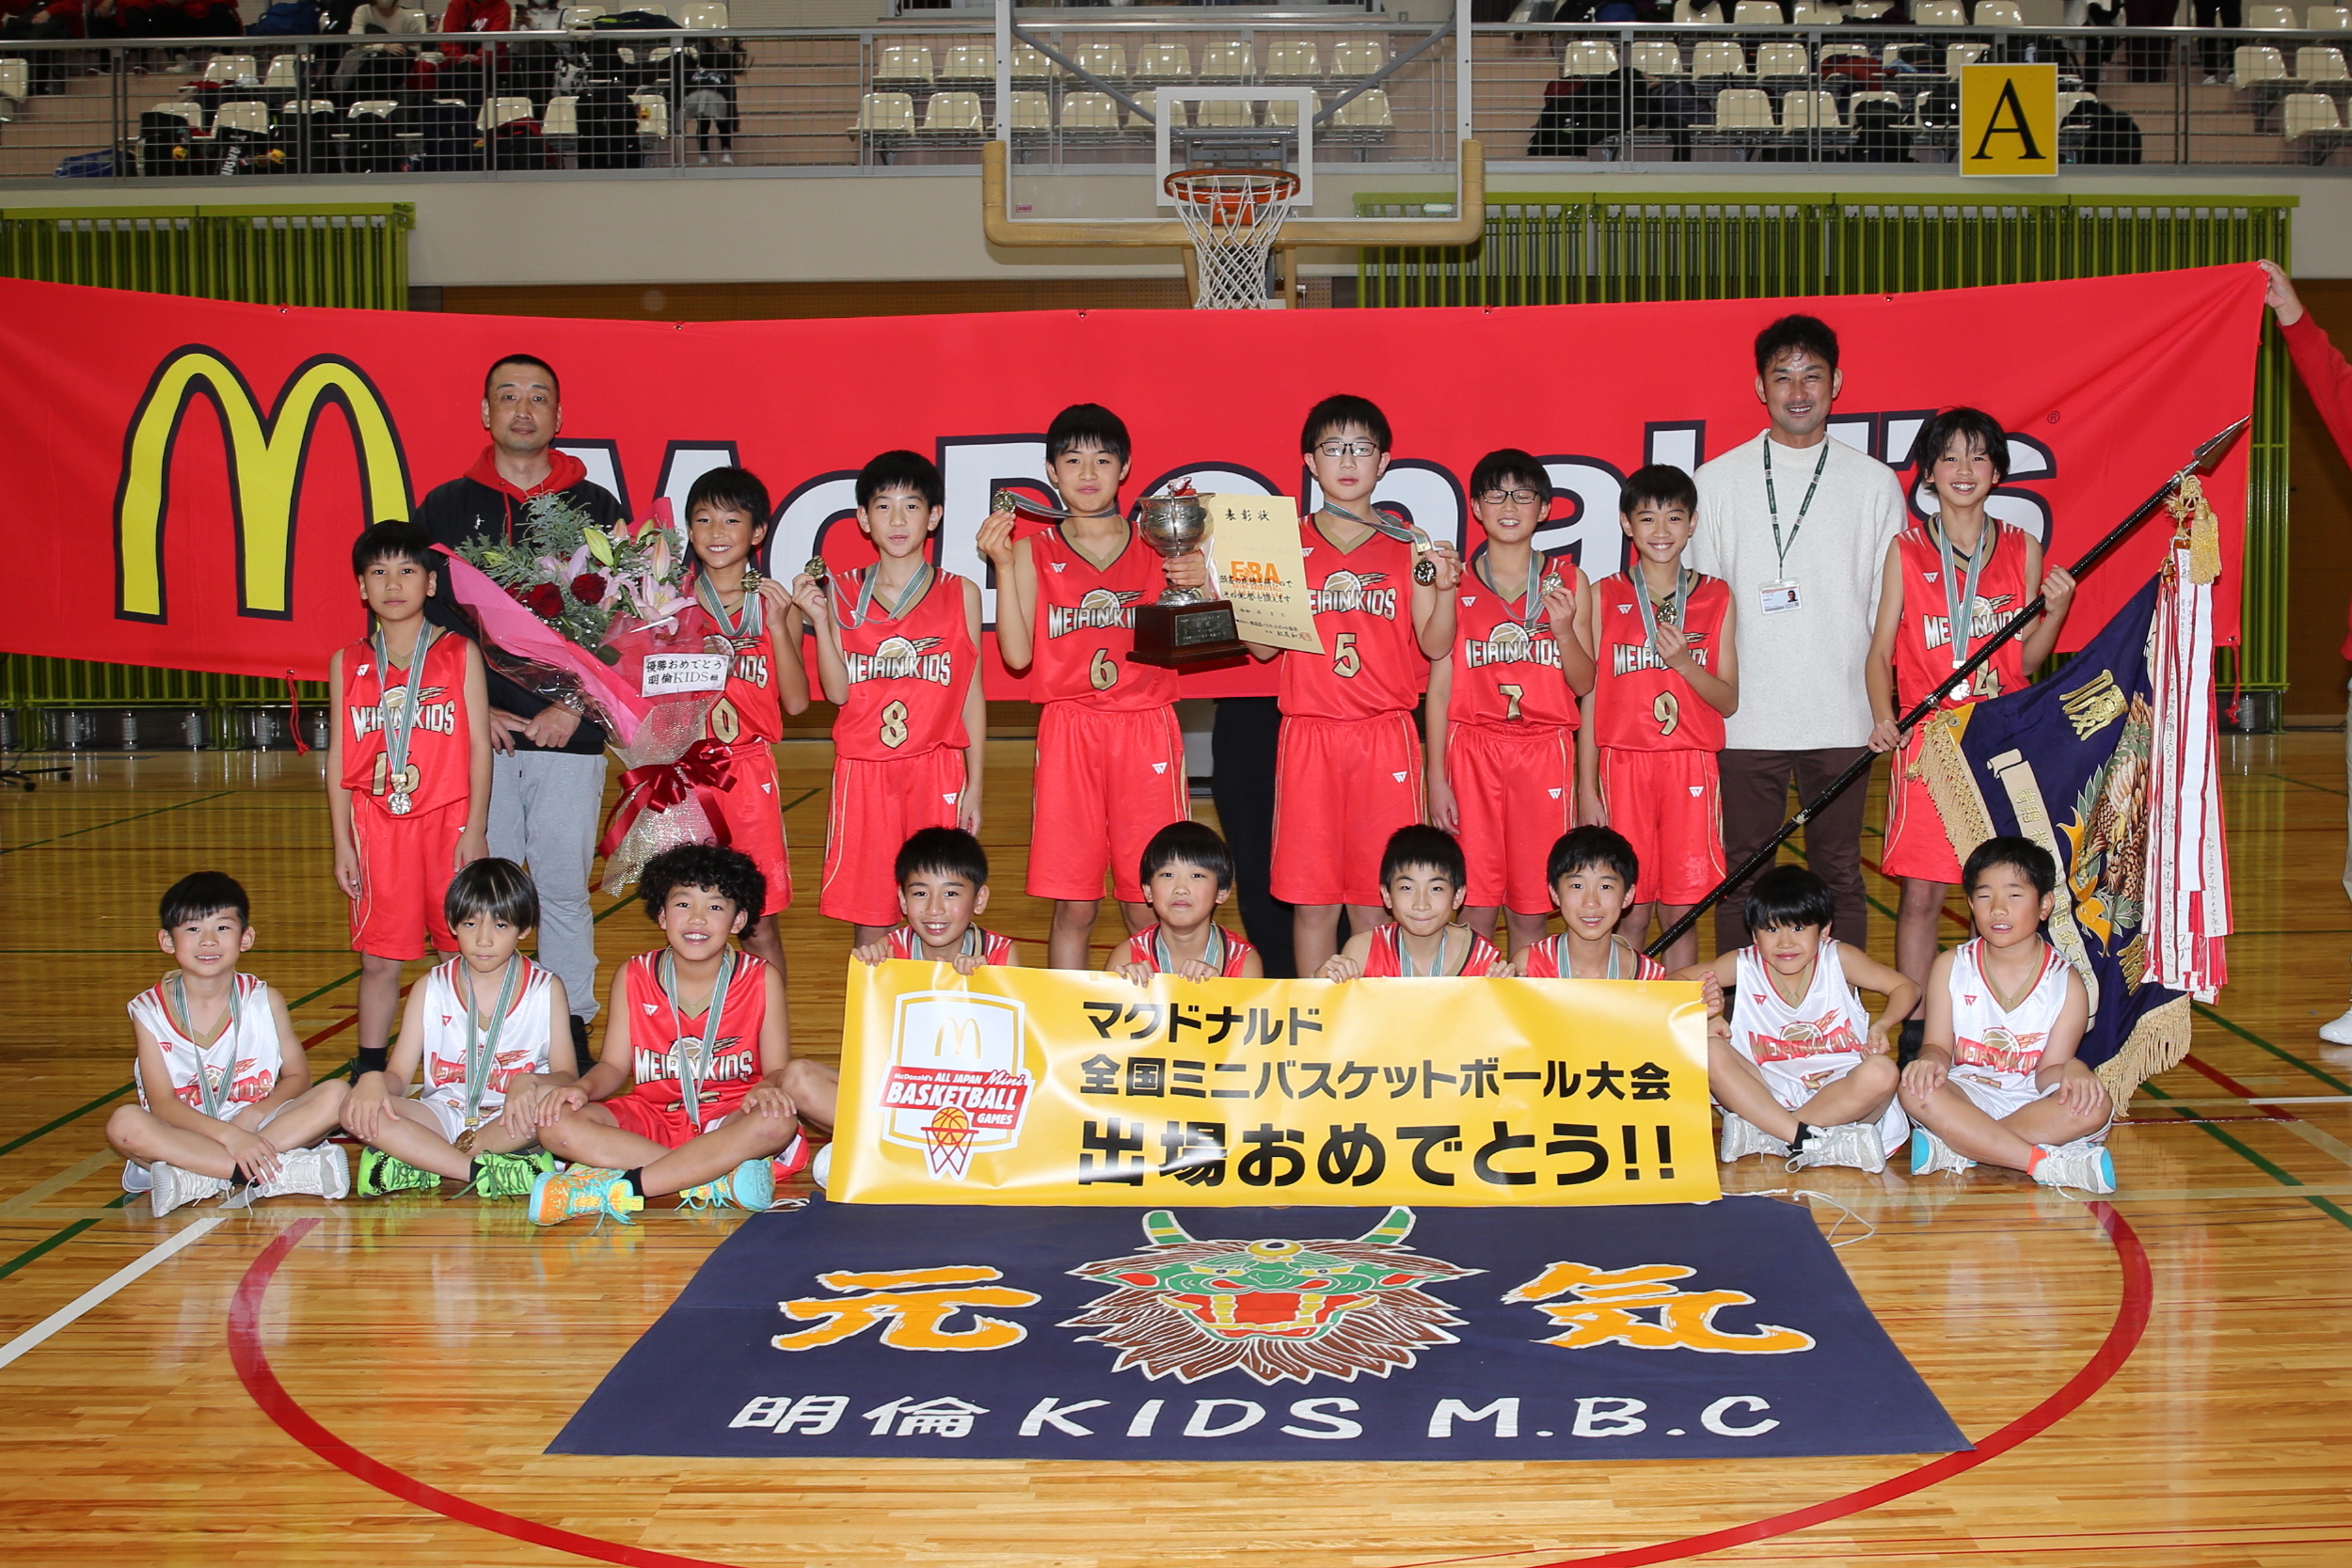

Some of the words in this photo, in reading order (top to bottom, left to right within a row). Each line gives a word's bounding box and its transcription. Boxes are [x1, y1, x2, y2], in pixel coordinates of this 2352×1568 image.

[1970, 78, 2047, 161] A
[1225, 507, 1270, 522] 表彰状
[1047, 602, 1110, 641] MEIRIN
[1112, 606, 1136, 630] KI
[1307, 587, 1356, 616] EIRIN
[1355, 587, 1398, 622] KIDS
[646, 659, 723, 673] 優勝おめでとう
[842, 649, 910, 686] MEIRIN
[909, 650, 952, 688] KIDS
[1089, 647, 1119, 691] 6
[1332, 632, 1361, 679] 5
[412, 699, 456, 736] KIDS
[1498, 684, 1525, 722] 7
[1653, 689, 1679, 736] 9
[880, 699, 909, 750] 8
[1083, 1001, 1323, 1046] マクドナルド
[633, 1045, 700, 1086] MEIRN
[706, 1050, 755, 1084] KIDS
[893, 1071, 933, 1082] McDonald's
[934, 1071, 950, 1083] ALL
[952, 1072, 983, 1085] JAPAN
[983, 1069, 1026, 1086] Mini
[1079, 1053, 1672, 1101] 全国ミニバスケットボール大会
[2007, 1049, 2043, 1077] KID
[886, 1081, 1018, 1111] BASKETBALL
[977, 1112, 1014, 1126] GAMES
[1077, 1117, 1676, 1187] 出場おめでとう!!
[727, 1394, 988, 1440] 明倫
[1018, 1396, 1362, 1440] KIDS
[1427, 1395, 1781, 1439] M.B.C
